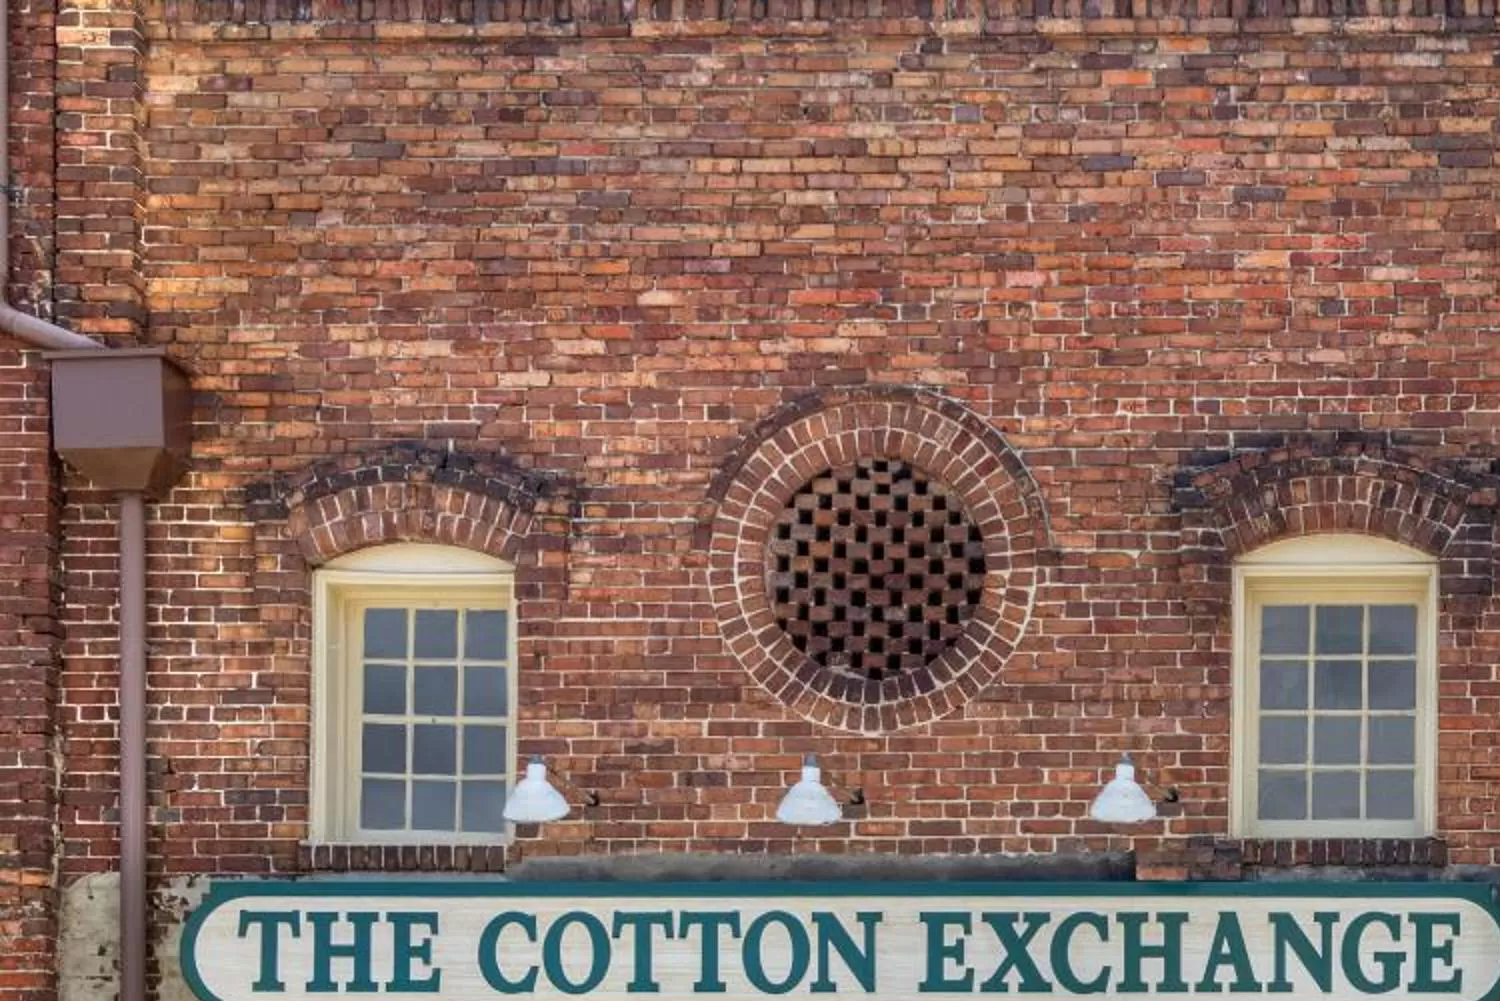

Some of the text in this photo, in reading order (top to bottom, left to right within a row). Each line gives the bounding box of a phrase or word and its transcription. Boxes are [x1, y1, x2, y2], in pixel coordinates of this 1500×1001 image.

[237, 909, 1463, 994] THE COTTON EXCHANGE
